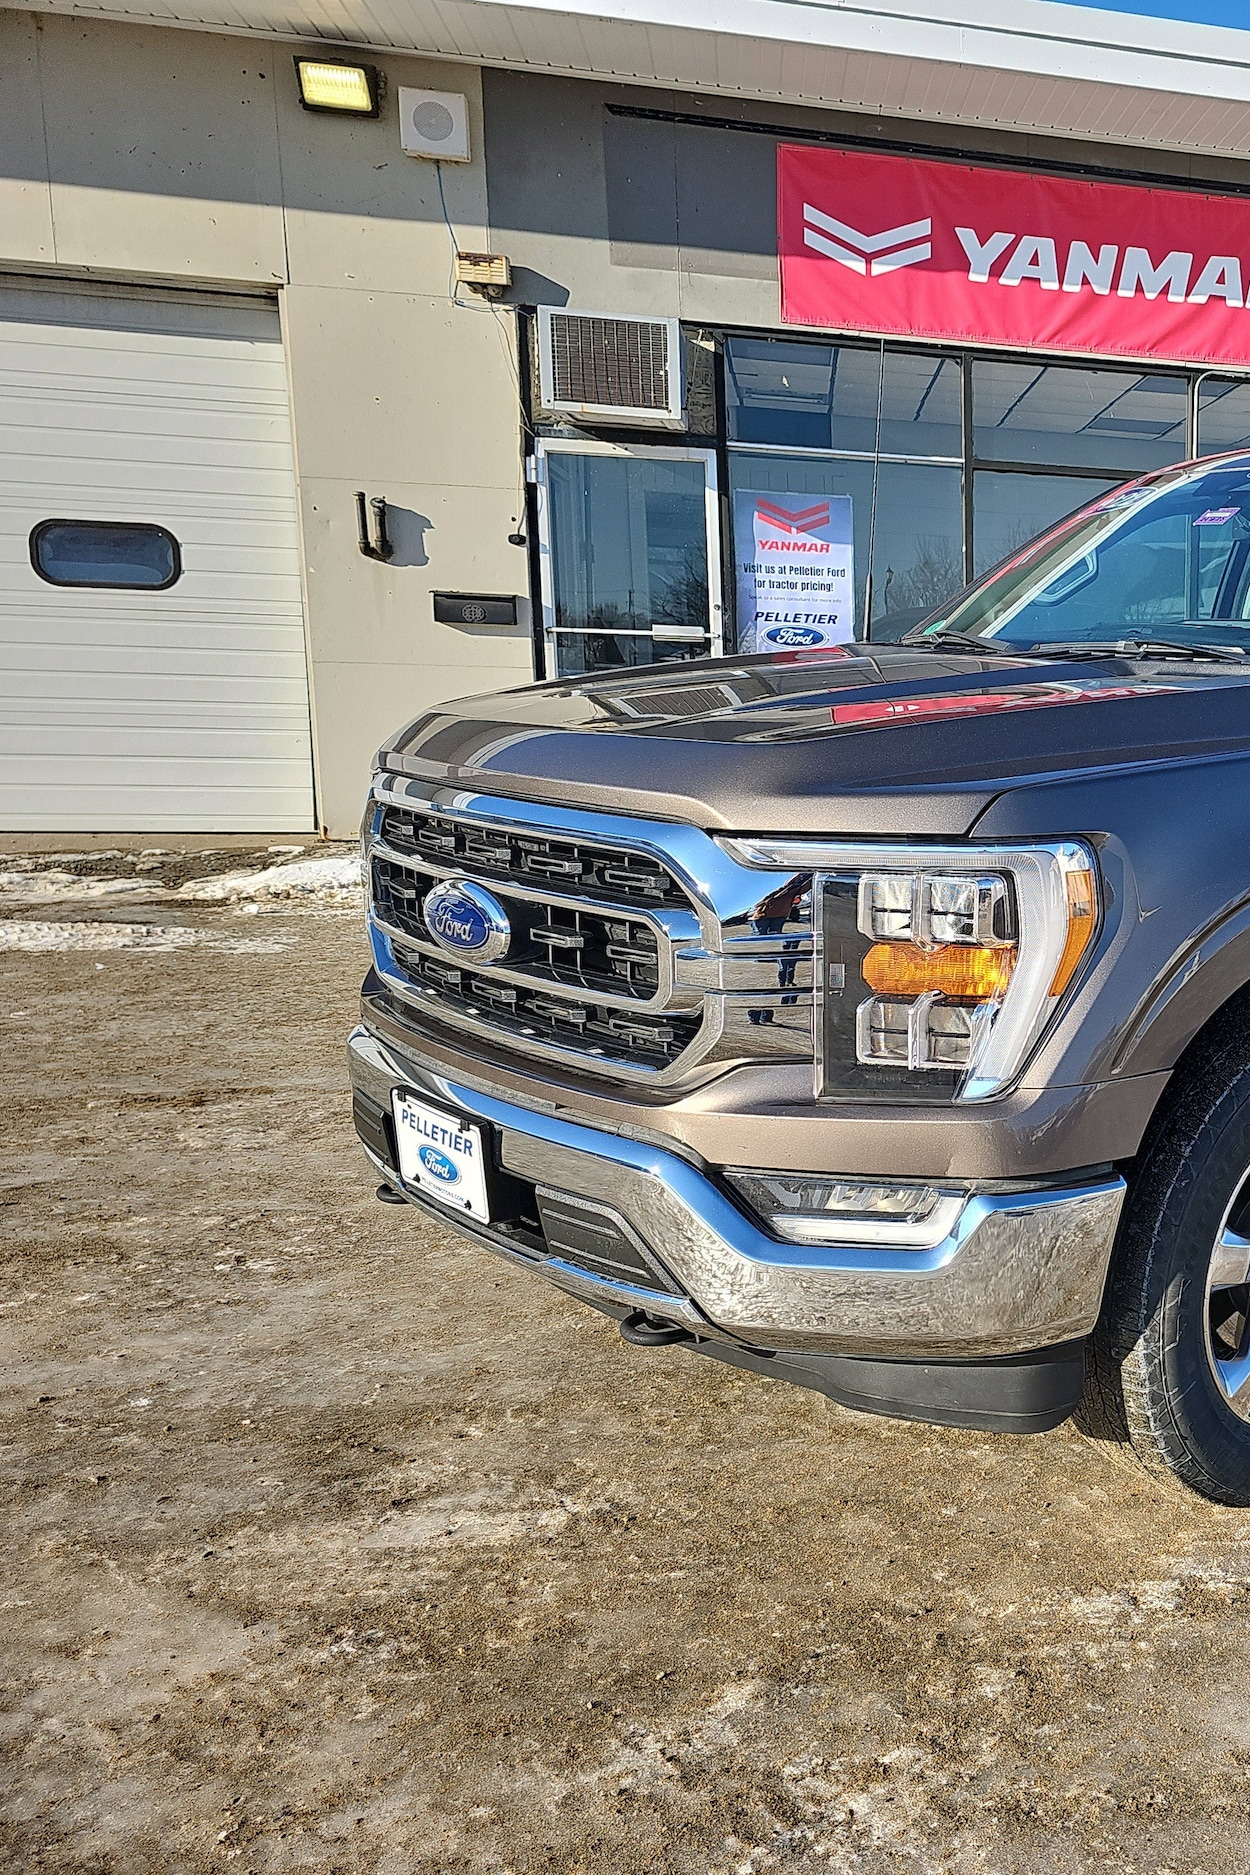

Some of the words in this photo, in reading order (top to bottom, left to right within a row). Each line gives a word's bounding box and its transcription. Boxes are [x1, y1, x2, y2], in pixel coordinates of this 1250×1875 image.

[758, 540, 830, 553] YANMAR
[743, 563, 762, 574] Visit
[764, 565, 776, 574] us
[778, 566, 787, 575] at
[789, 565, 824, 577] Pelletier
[827, 567, 846, 577] Ford
[754, 578, 766, 589] for
[768, 579, 798, 590] tractor
[801, 581, 834, 592] pricing!
[754, 611, 837, 624] PELLETIER
[776, 628, 814, 645] Ford
[434, 902, 474, 941] Ford
[402, 1108, 473, 1158] PELLETIER
[424, 1149, 451, 1179] Ford
